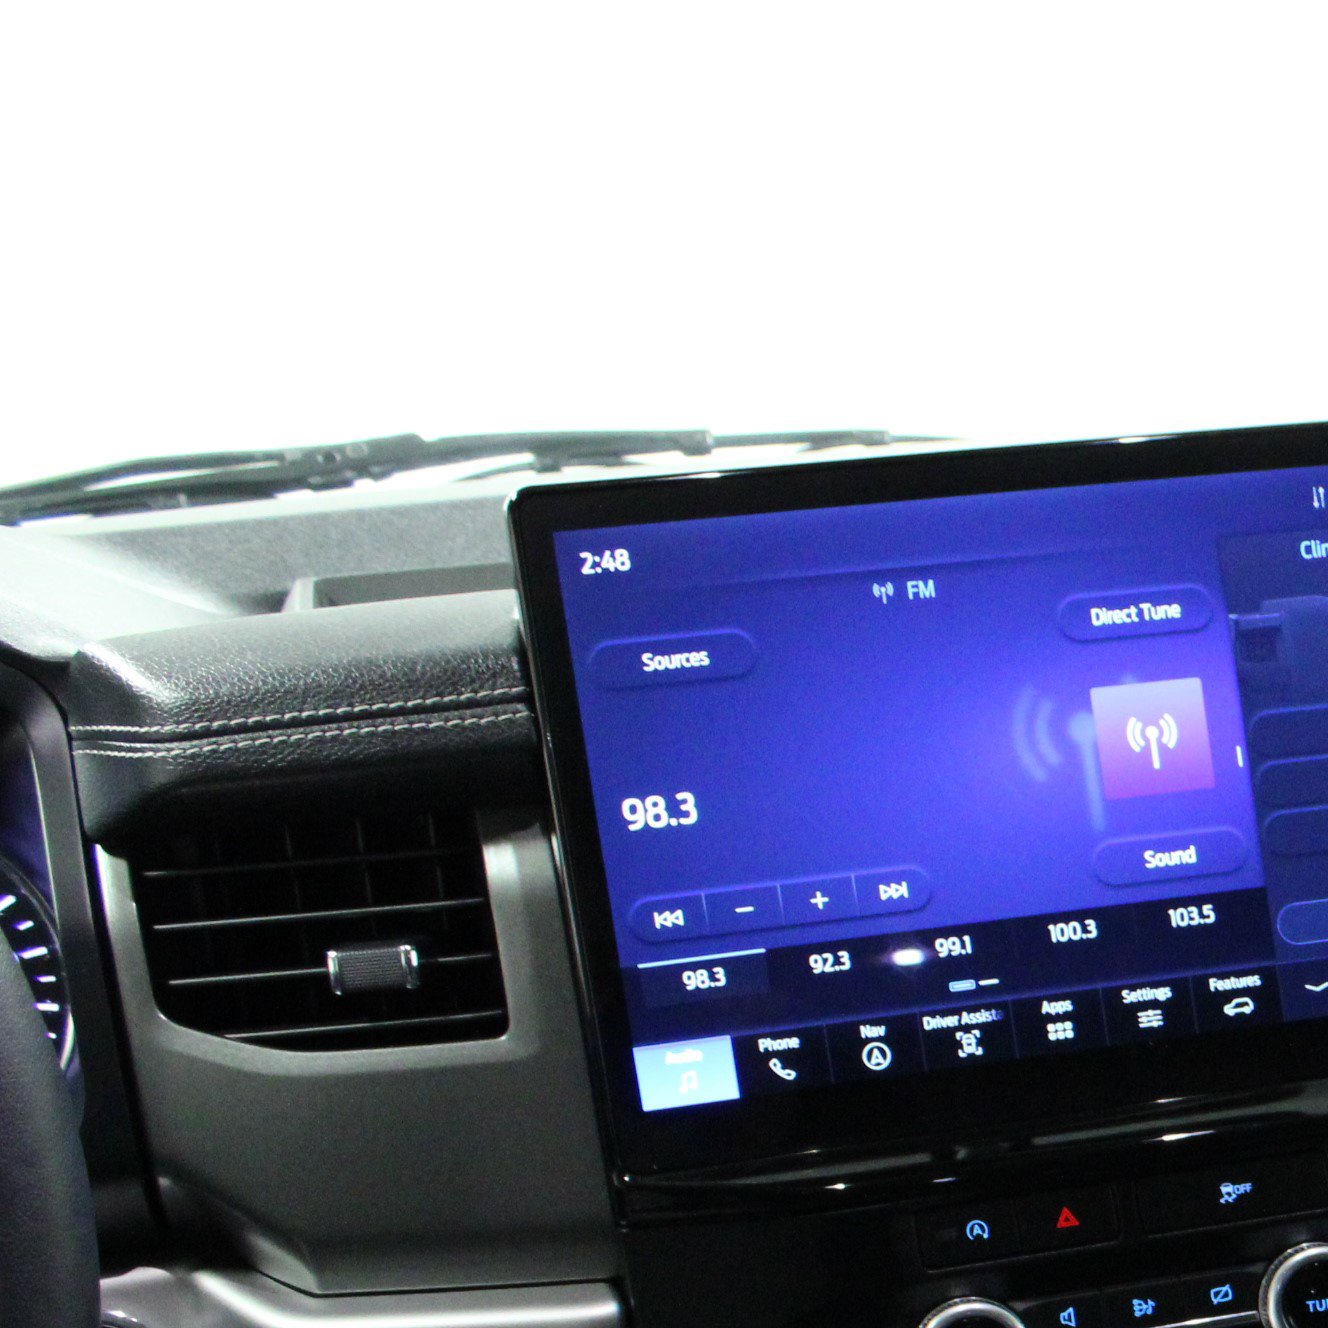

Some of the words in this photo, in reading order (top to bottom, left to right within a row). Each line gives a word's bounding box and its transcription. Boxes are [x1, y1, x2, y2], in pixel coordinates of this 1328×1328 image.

[579, 548, 631, 575] 2:48
[906, 579, 936, 600] FM
[1090, 604, 1137, 627] Direct
[1139, 602, 1181, 622] Tune
[641, 649, 710, 672] Sources
[621, 792, 698, 831] 98.3
[1143, 845, 1197, 869] Sound
[1167, 904, 1216, 928] 103.5
[1047, 919, 1098, 944] 100.3
[934, 935, 972, 957] 99.1
[808, 951, 851, 974] 92.3
[681, 967, 727, 991] 98.3
[1208, 973, 1261, 993] Features
[1121, 984, 1172, 1005] Settings
[1041, 998, 1073, 1016] Apps
[860, 1024, 886, 1039] Nav
[922, 1015, 959, 1030] Driver
[758, 1035, 800, 1053] Phone
[1233, 1181, 1253, 1196] OFF
